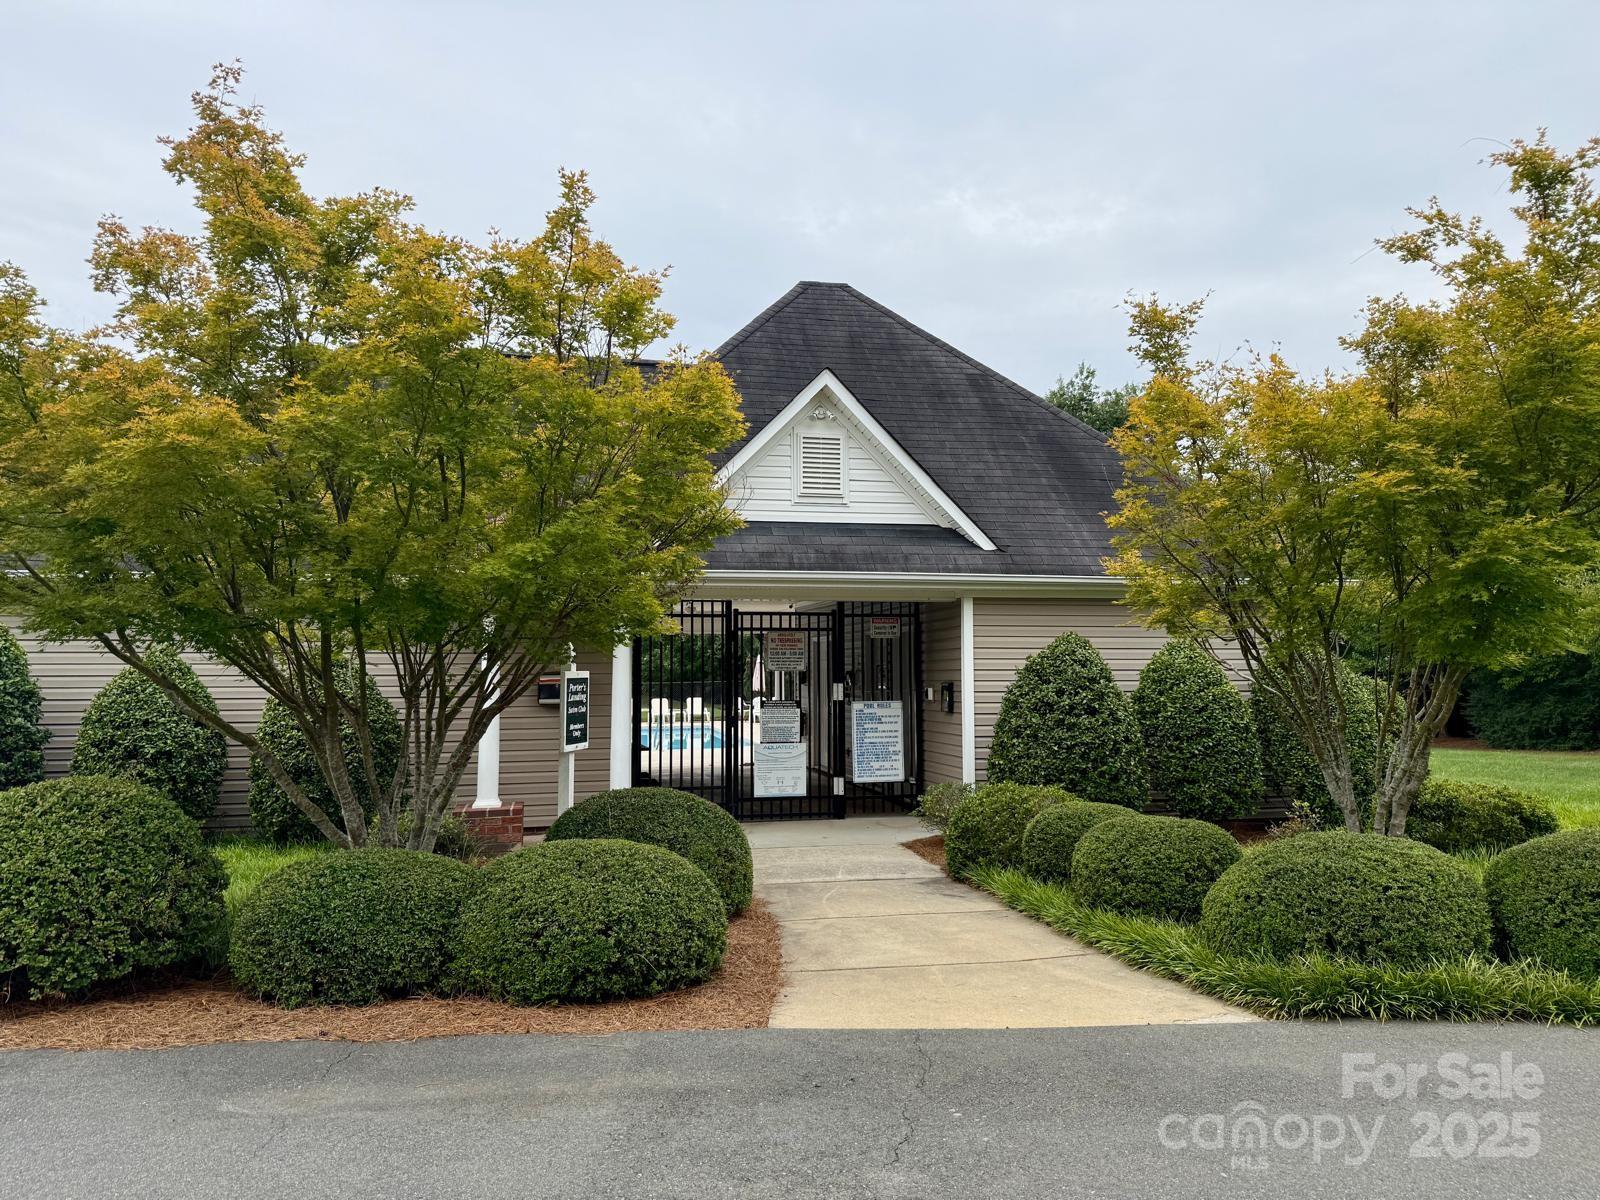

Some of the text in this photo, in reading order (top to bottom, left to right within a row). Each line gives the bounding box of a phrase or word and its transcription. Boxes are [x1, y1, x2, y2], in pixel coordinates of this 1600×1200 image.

[569, 683, 586, 692] Porter's
[568, 693, 586, 702] Landing
[568, 706, 578, 714] Swim
